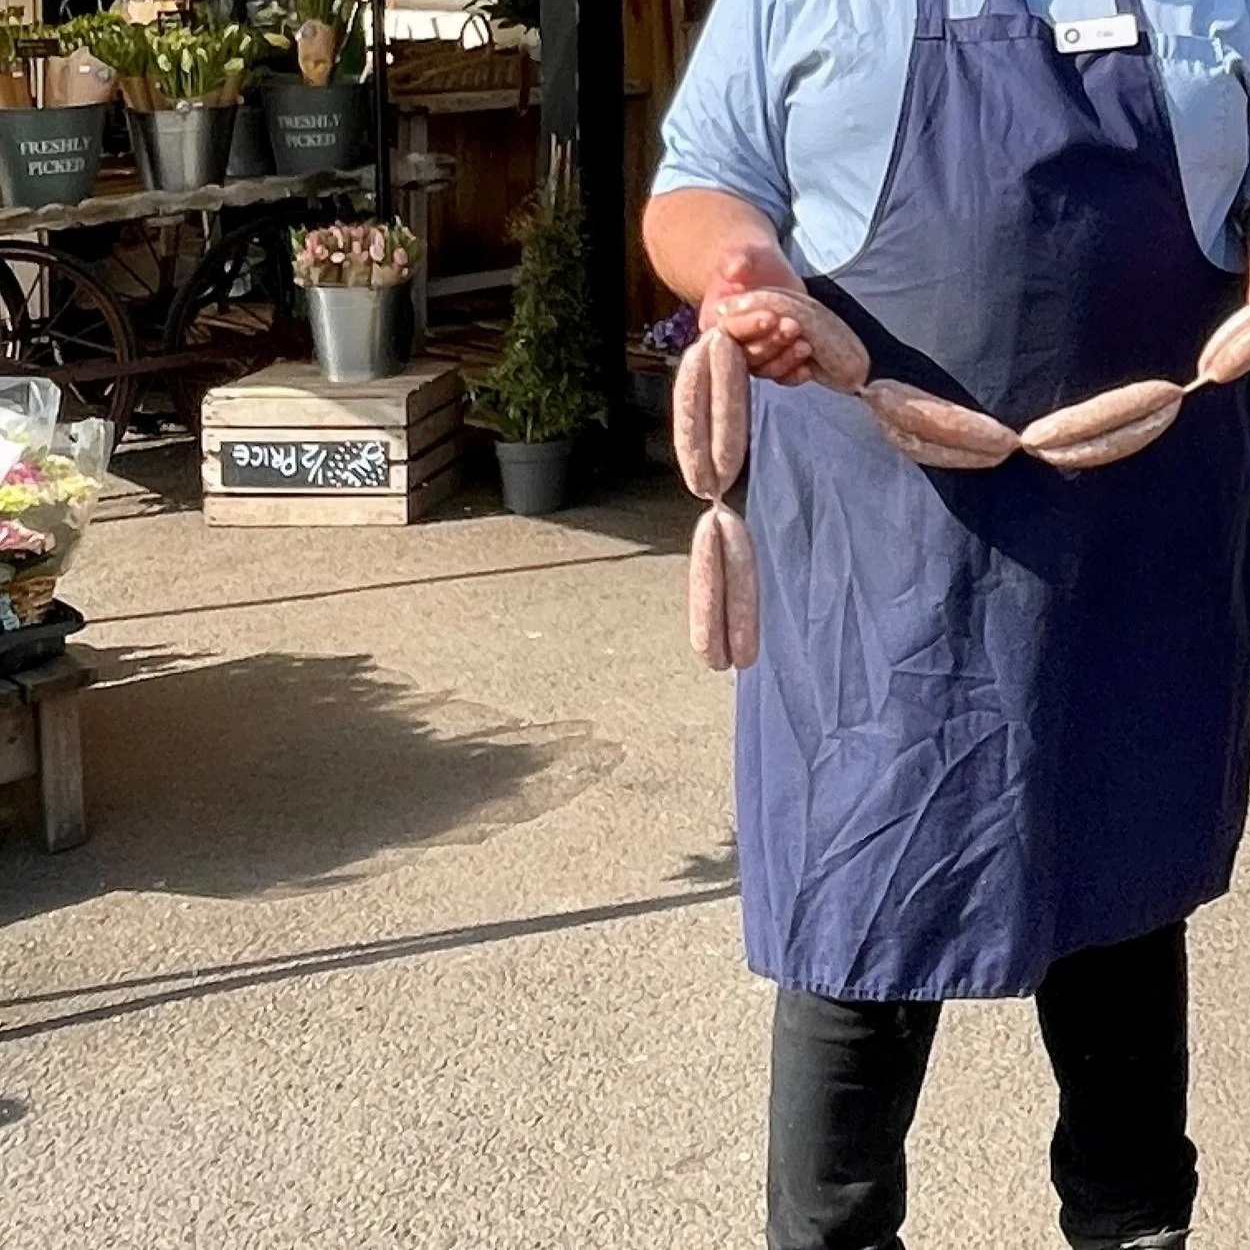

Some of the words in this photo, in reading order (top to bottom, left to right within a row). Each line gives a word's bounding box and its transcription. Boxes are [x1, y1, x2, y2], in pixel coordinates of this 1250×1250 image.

[277, 113, 344, 131] FRESHLY
[18, 136, 93, 155] FRESHLY
[285, 132, 337, 148] PICKED
[28, 157, 86, 176] PICKED
